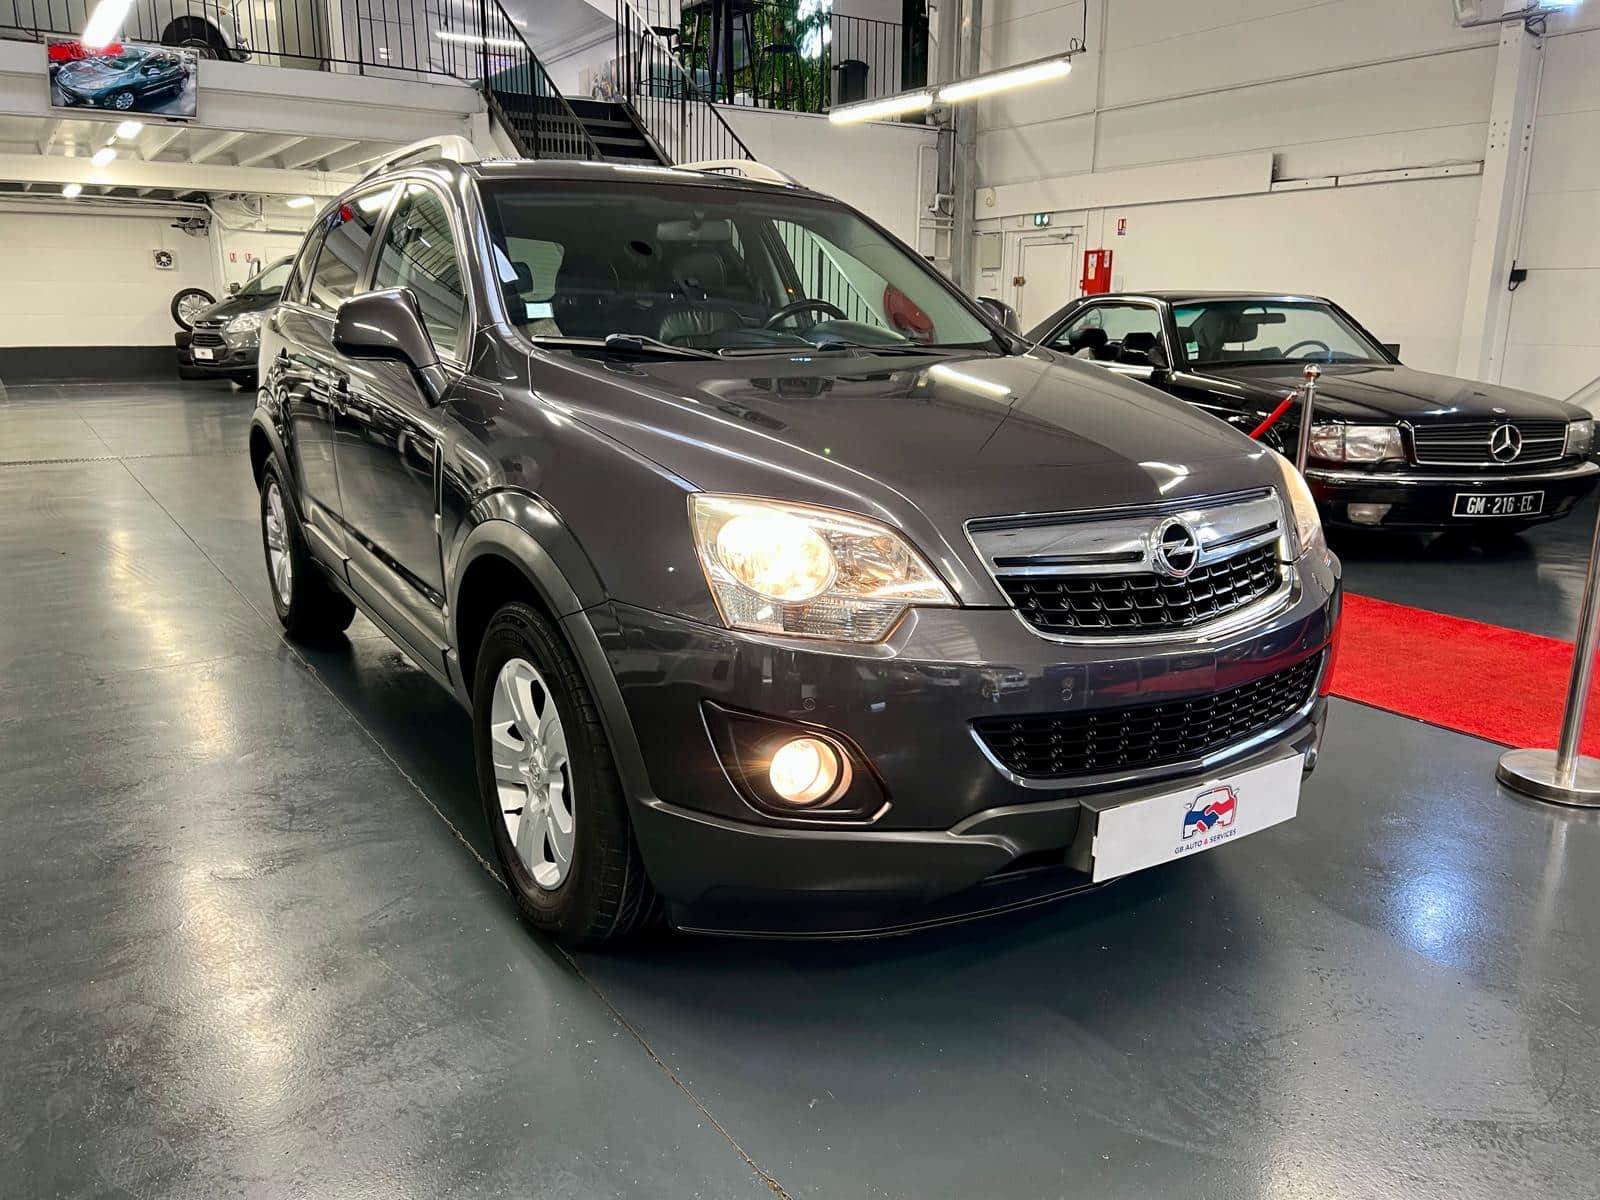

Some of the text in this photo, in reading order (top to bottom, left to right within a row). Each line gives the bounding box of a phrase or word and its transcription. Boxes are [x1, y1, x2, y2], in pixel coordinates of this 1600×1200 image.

[1466, 496, 1486, 514] GM
[1492, 496, 1515, 514] 216
[1185, 840, 1203, 850] AUTO
[1209, 828, 1237, 843] SERVICES
